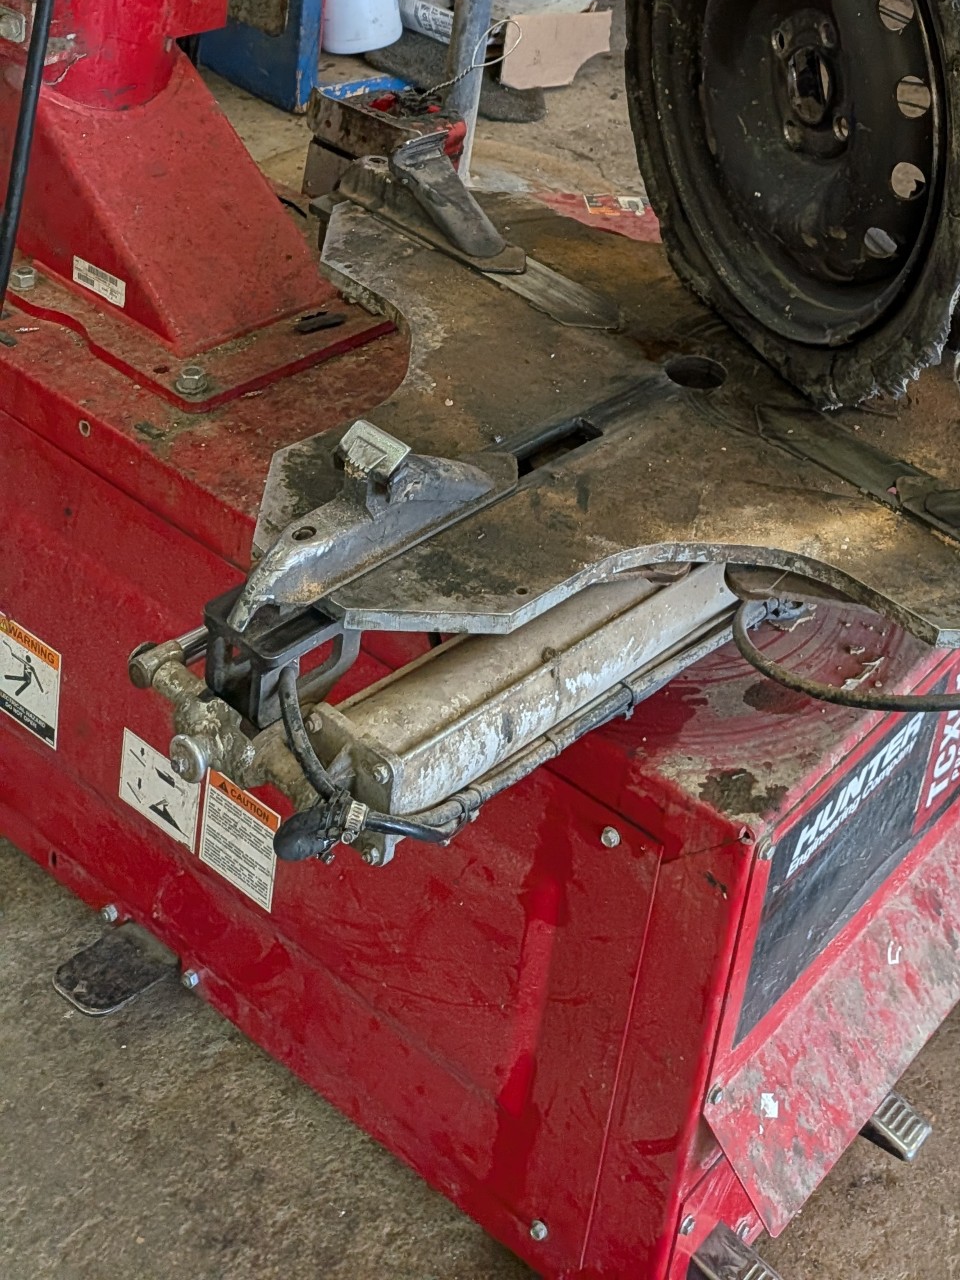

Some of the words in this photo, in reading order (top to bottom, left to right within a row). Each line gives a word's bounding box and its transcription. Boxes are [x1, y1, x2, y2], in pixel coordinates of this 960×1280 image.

[9, 624, 55, 665] WARNING
[230, 788, 270, 823] CAUTION
[786, 711, 927, 879] HUNTER
[791, 796, 863, 871] Engineering
[862, 736, 918, 800] Company
